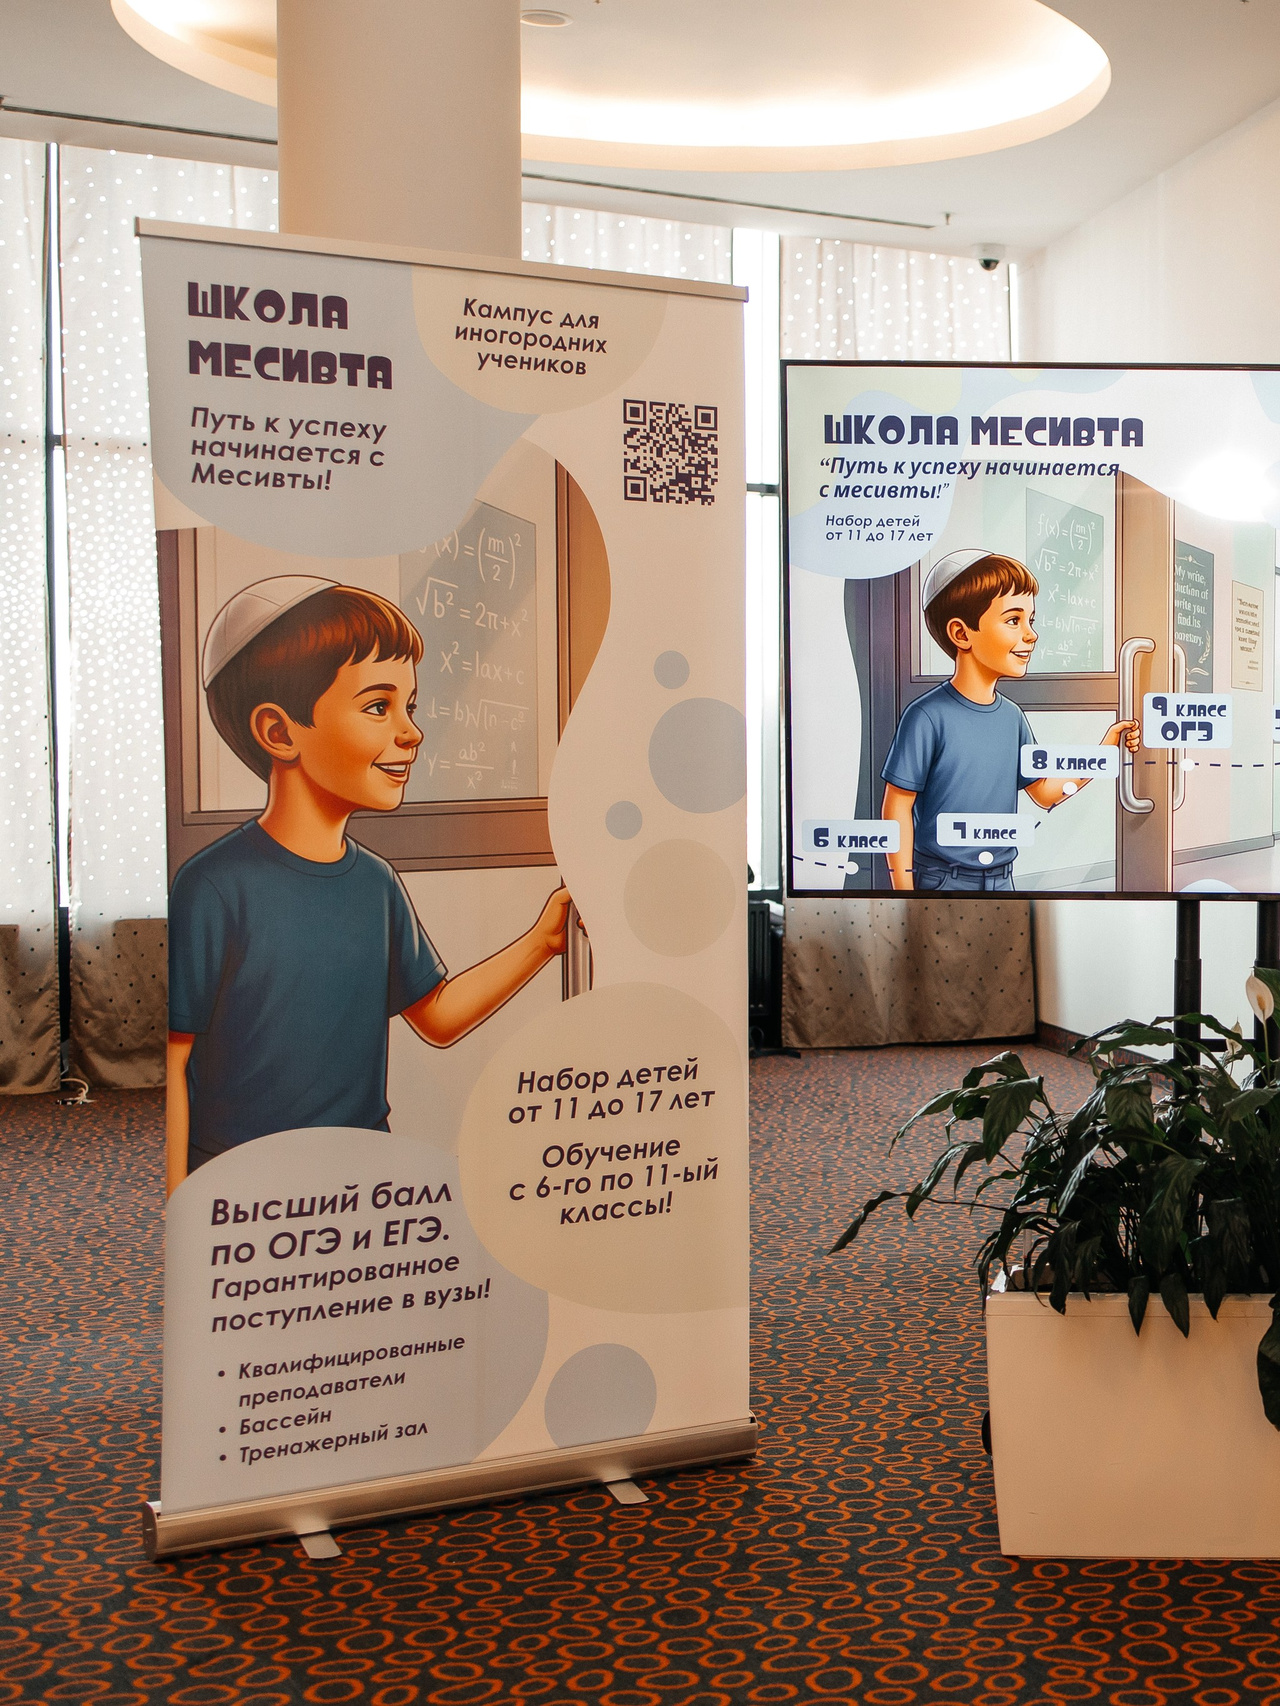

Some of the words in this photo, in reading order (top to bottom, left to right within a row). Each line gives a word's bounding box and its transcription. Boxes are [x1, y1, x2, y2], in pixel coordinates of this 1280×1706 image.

[187, 281, 349, 330] ШКОЛА
[463, 297, 554, 327] Кампус
[559, 312, 600, 330] для
[455, 325, 608, 354] иногородних
[188, 339, 393, 390] МЕСИВТА
[477, 351, 587, 375] учеников
[190, 406, 256, 435] Путь
[264, 416, 281, 434] к
[288, 418, 388, 445] успеху
[823, 414, 959, 446] ШКОЛА
[970, 415, 1144, 448] МЕСИВТА
[191, 439, 361, 465] начинается
[369, 450, 385, 467] с
[820, 456, 888, 479] “Путь
[893, 461, 906, 475] к
[908, 461, 982, 481] успеху
[984, 461, 1120, 479] начинается
[191, 462, 332, 491] Месивты!
[819, 484, 830, 498] с
[833, 482, 950, 499] месивты!”
[825, 514, 873, 530] Набор
[875, 514, 920, 528] детей
[825, 531, 843, 541] от
[848, 529, 861, 541] 11
[865, 532, 885, 542] до
[890, 529, 905, 541] 17
[908, 532, 934, 542] лет
[1152, 696, 1168, 717] 9
[1176, 704, 1227, 718] класс
[1160, 720, 1213, 742] ОГЭ
[1032, 749, 1048, 770] 8
[1056, 757, 1107, 771] класс
[813, 827, 829, 848] 6
[837, 835, 888, 849] класс
[952, 821, 967, 840] 7
[973, 828, 1017, 840] класс
[517, 1067, 610, 1094] Набор
[616, 1056, 698, 1089] детей
[508, 1105, 543, 1125] от
[554, 1096, 578, 1121] 11
[587, 1098, 624, 1120] до
[636, 1089, 663, 1114] 17
[668, 1090, 716, 1111] лет
[542, 1139, 681, 1171] Обучение
[509, 1183, 526, 1201] с
[536, 1175, 592, 1199] 6-го
[600, 1172, 634, 1192] по
[645, 1156, 719, 1187] 11-ый
[210, 1183, 360, 1226] Высший
[371, 1181, 453, 1210] балл
[560, 1190, 673, 1225] классы!
[211, 1242, 256, 1266] по
[268, 1226, 342, 1260] ОГЭ
[352, 1229, 372, 1251] и
[383, 1215, 450, 1247] ЕГЭ.
[211, 1255, 463, 1301] Гарантированное
[211, 1295, 394, 1333] поступление
[401, 1293, 415, 1309] в
[423, 1277, 491, 1310] вузы!
[238, 1337, 466, 1380] Квалифицированные
[238, 1370, 406, 1412] преподаватели
[239, 1407, 332, 1436] Бассейн
[239, 1424, 389, 1466] Тренажерный
[394, 1422, 428, 1439] зал
